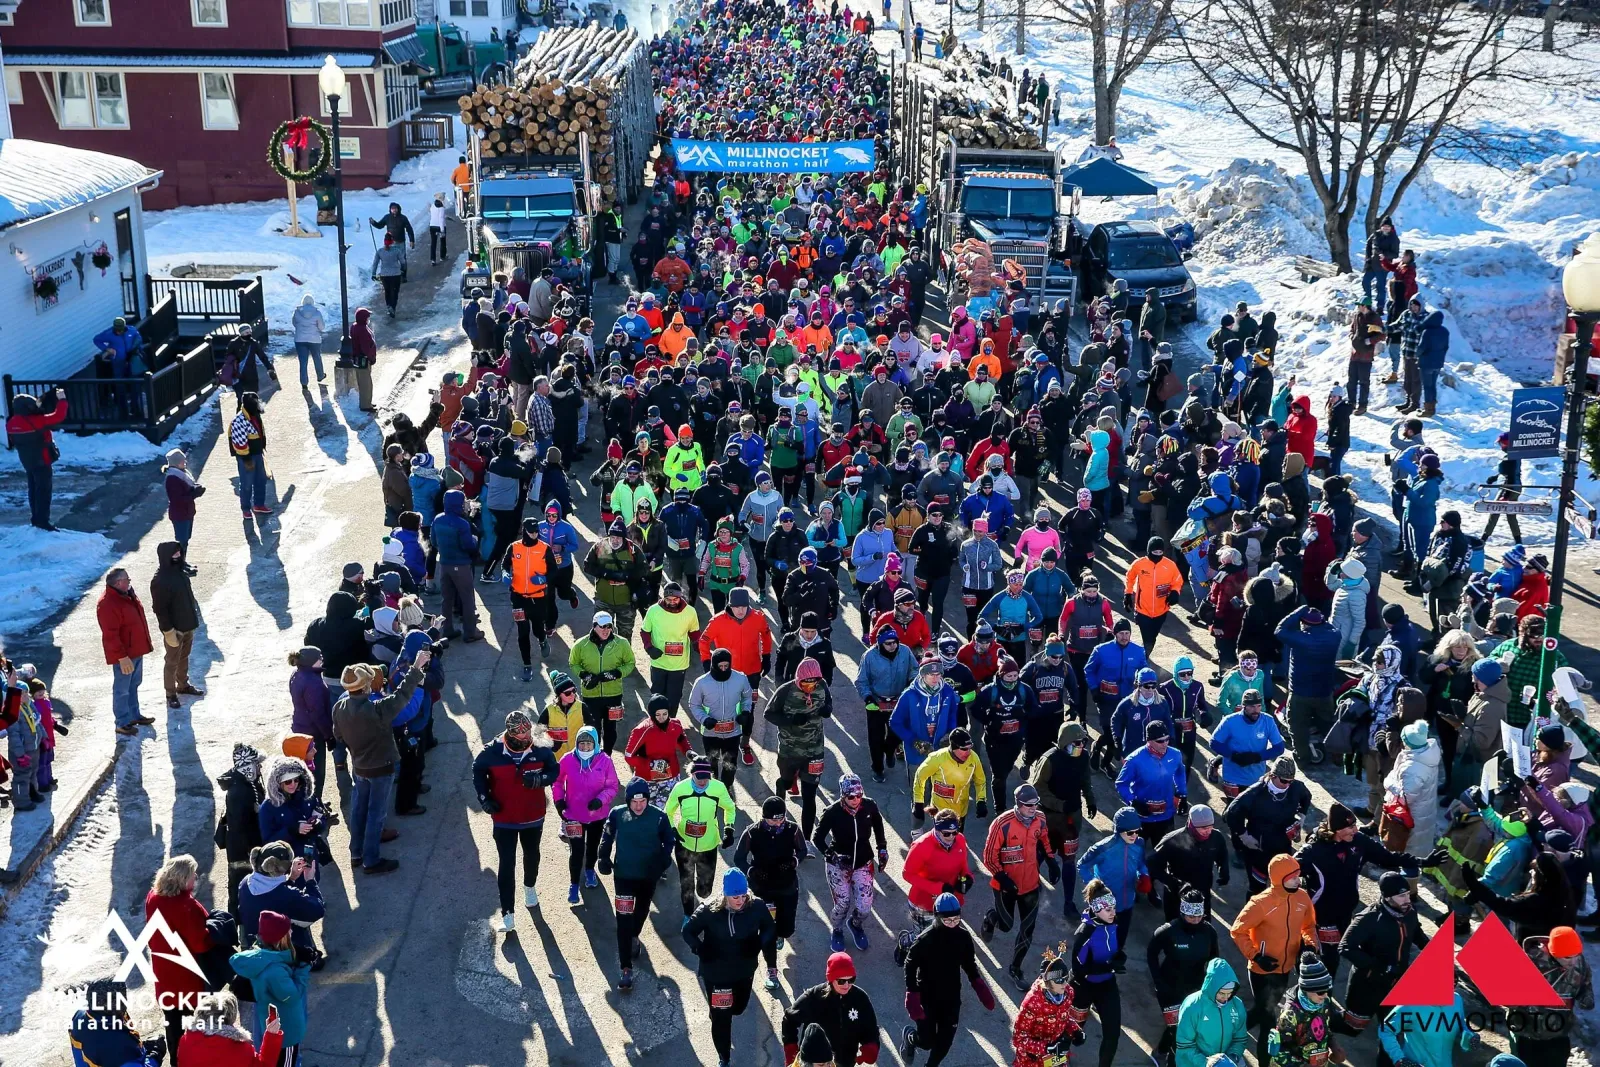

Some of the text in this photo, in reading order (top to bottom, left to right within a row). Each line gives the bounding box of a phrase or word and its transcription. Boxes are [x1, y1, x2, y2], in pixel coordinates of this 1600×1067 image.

[727, 146, 829, 159] MILLINOCKET
[727, 159, 829, 168] marathon half
[1518, 431, 1551, 440] DOWNTOWN
[1512, 437, 1556, 447] MILLINOCKET
[1036, 675, 1064, 689] UNH
